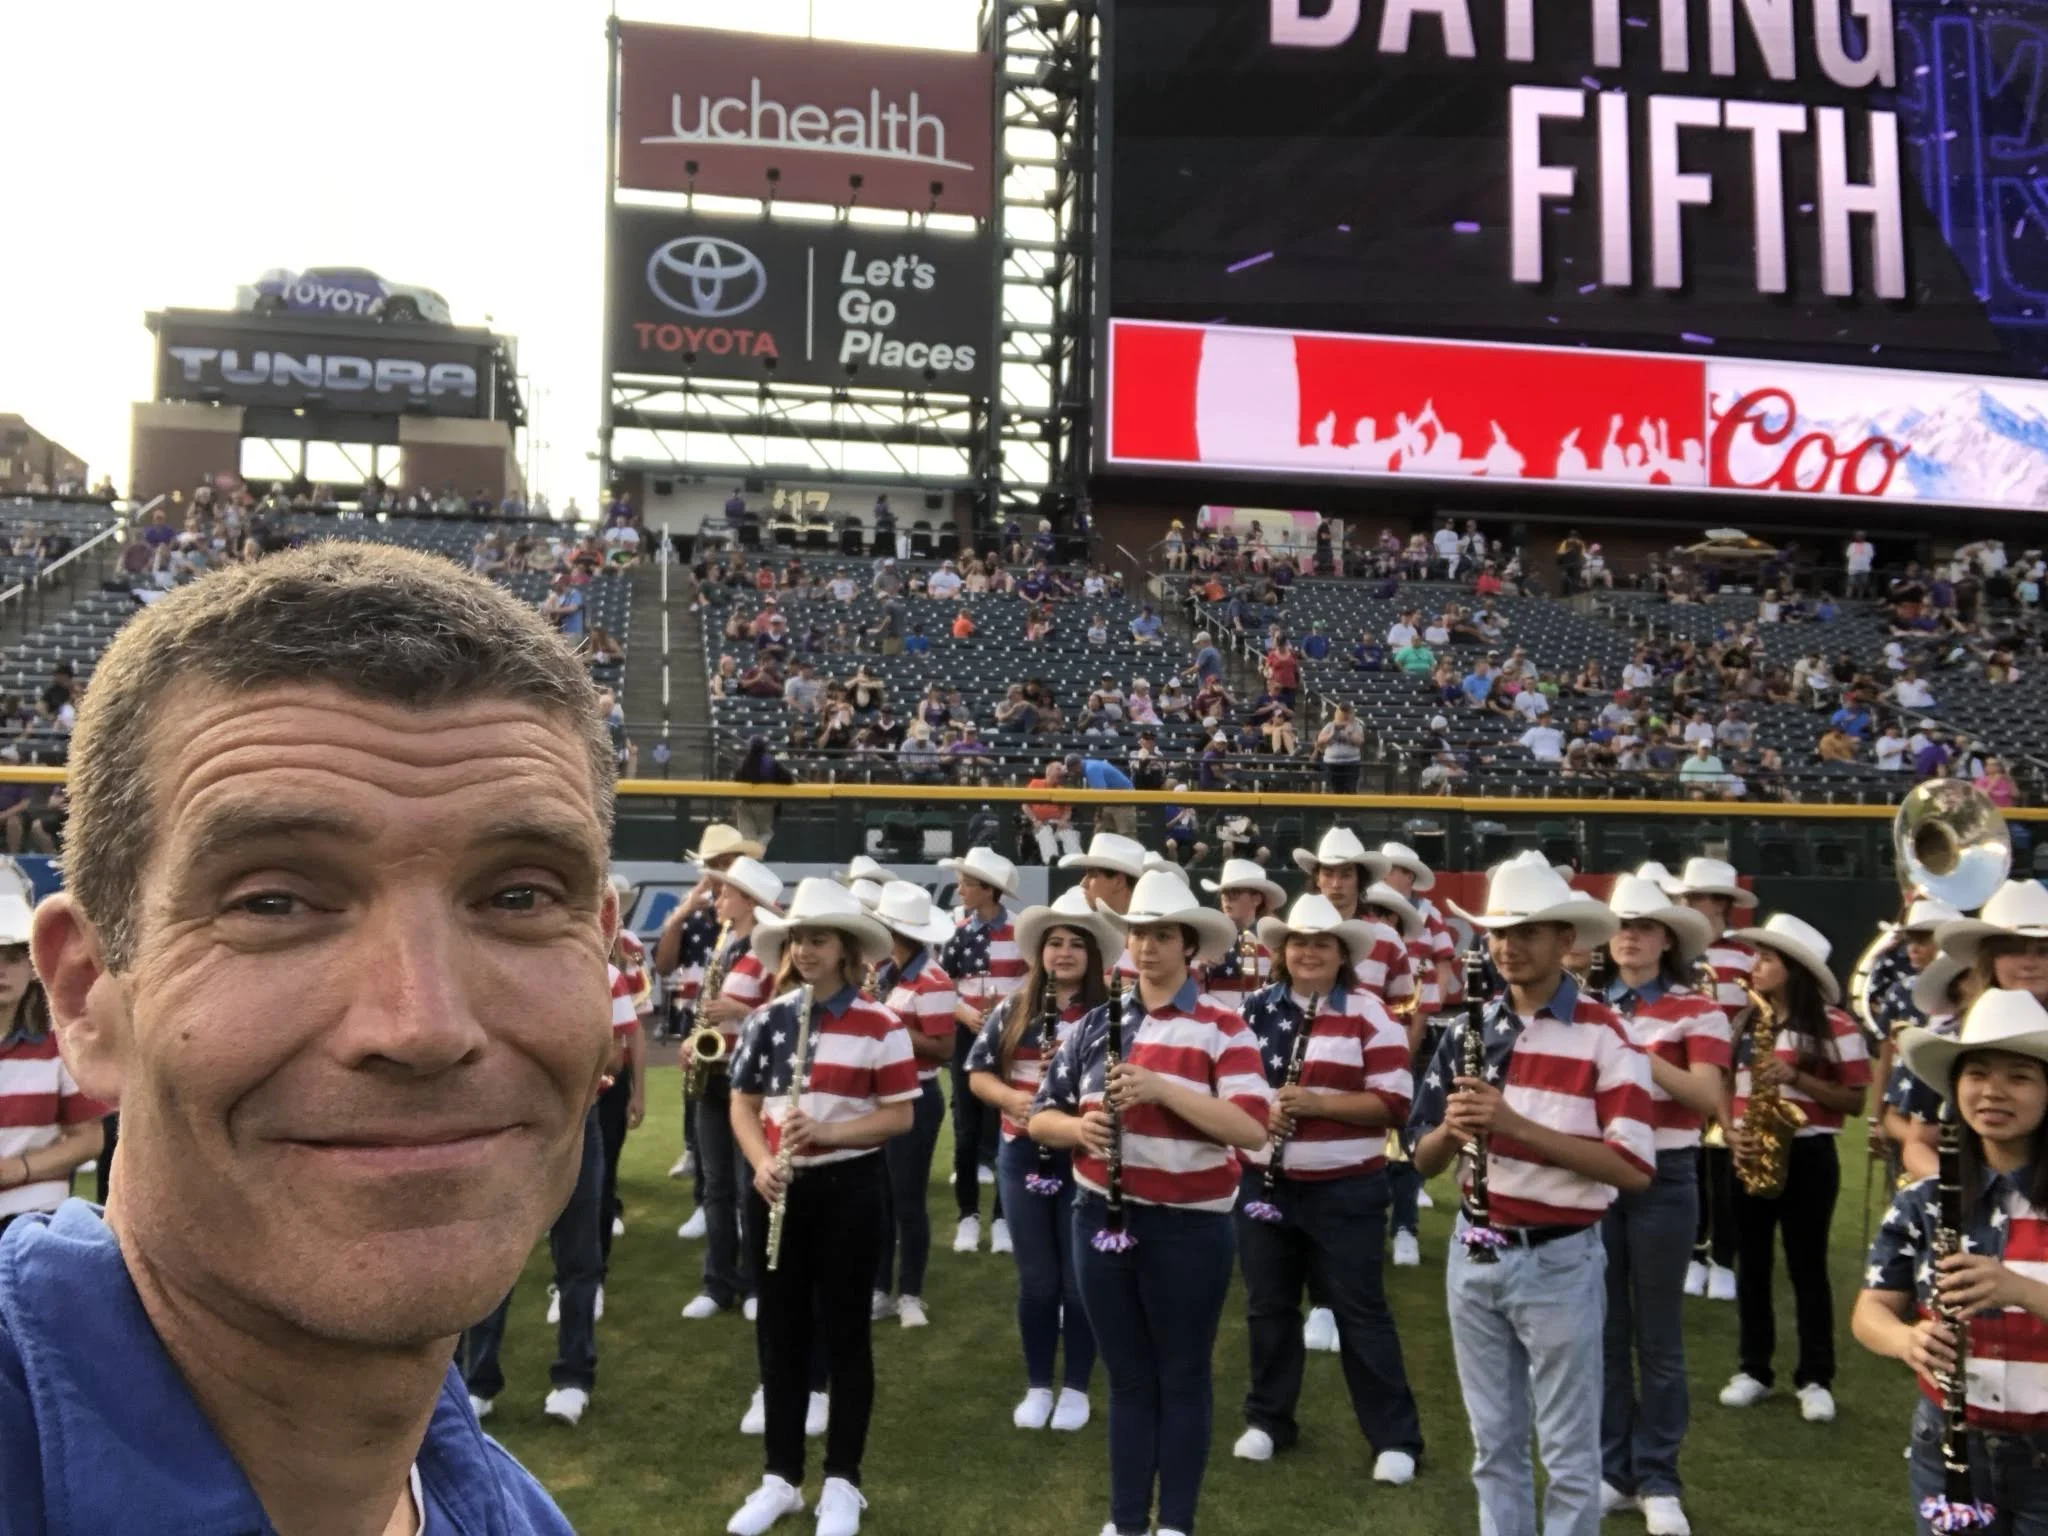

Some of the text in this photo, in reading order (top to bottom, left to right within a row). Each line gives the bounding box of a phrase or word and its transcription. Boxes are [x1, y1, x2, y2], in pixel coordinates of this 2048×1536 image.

[672, 76, 946, 162] uchealth
[1510, 84, 1906, 299] FIFTH
[840, 249, 936, 290] Let's
[282, 279, 385, 315] TOYOTA
[838, 289, 896, 326] Go
[633, 322, 780, 358] TOYOTA
[839, 329, 977, 372] Places
[167, 346, 477, 398] TUNDRA
